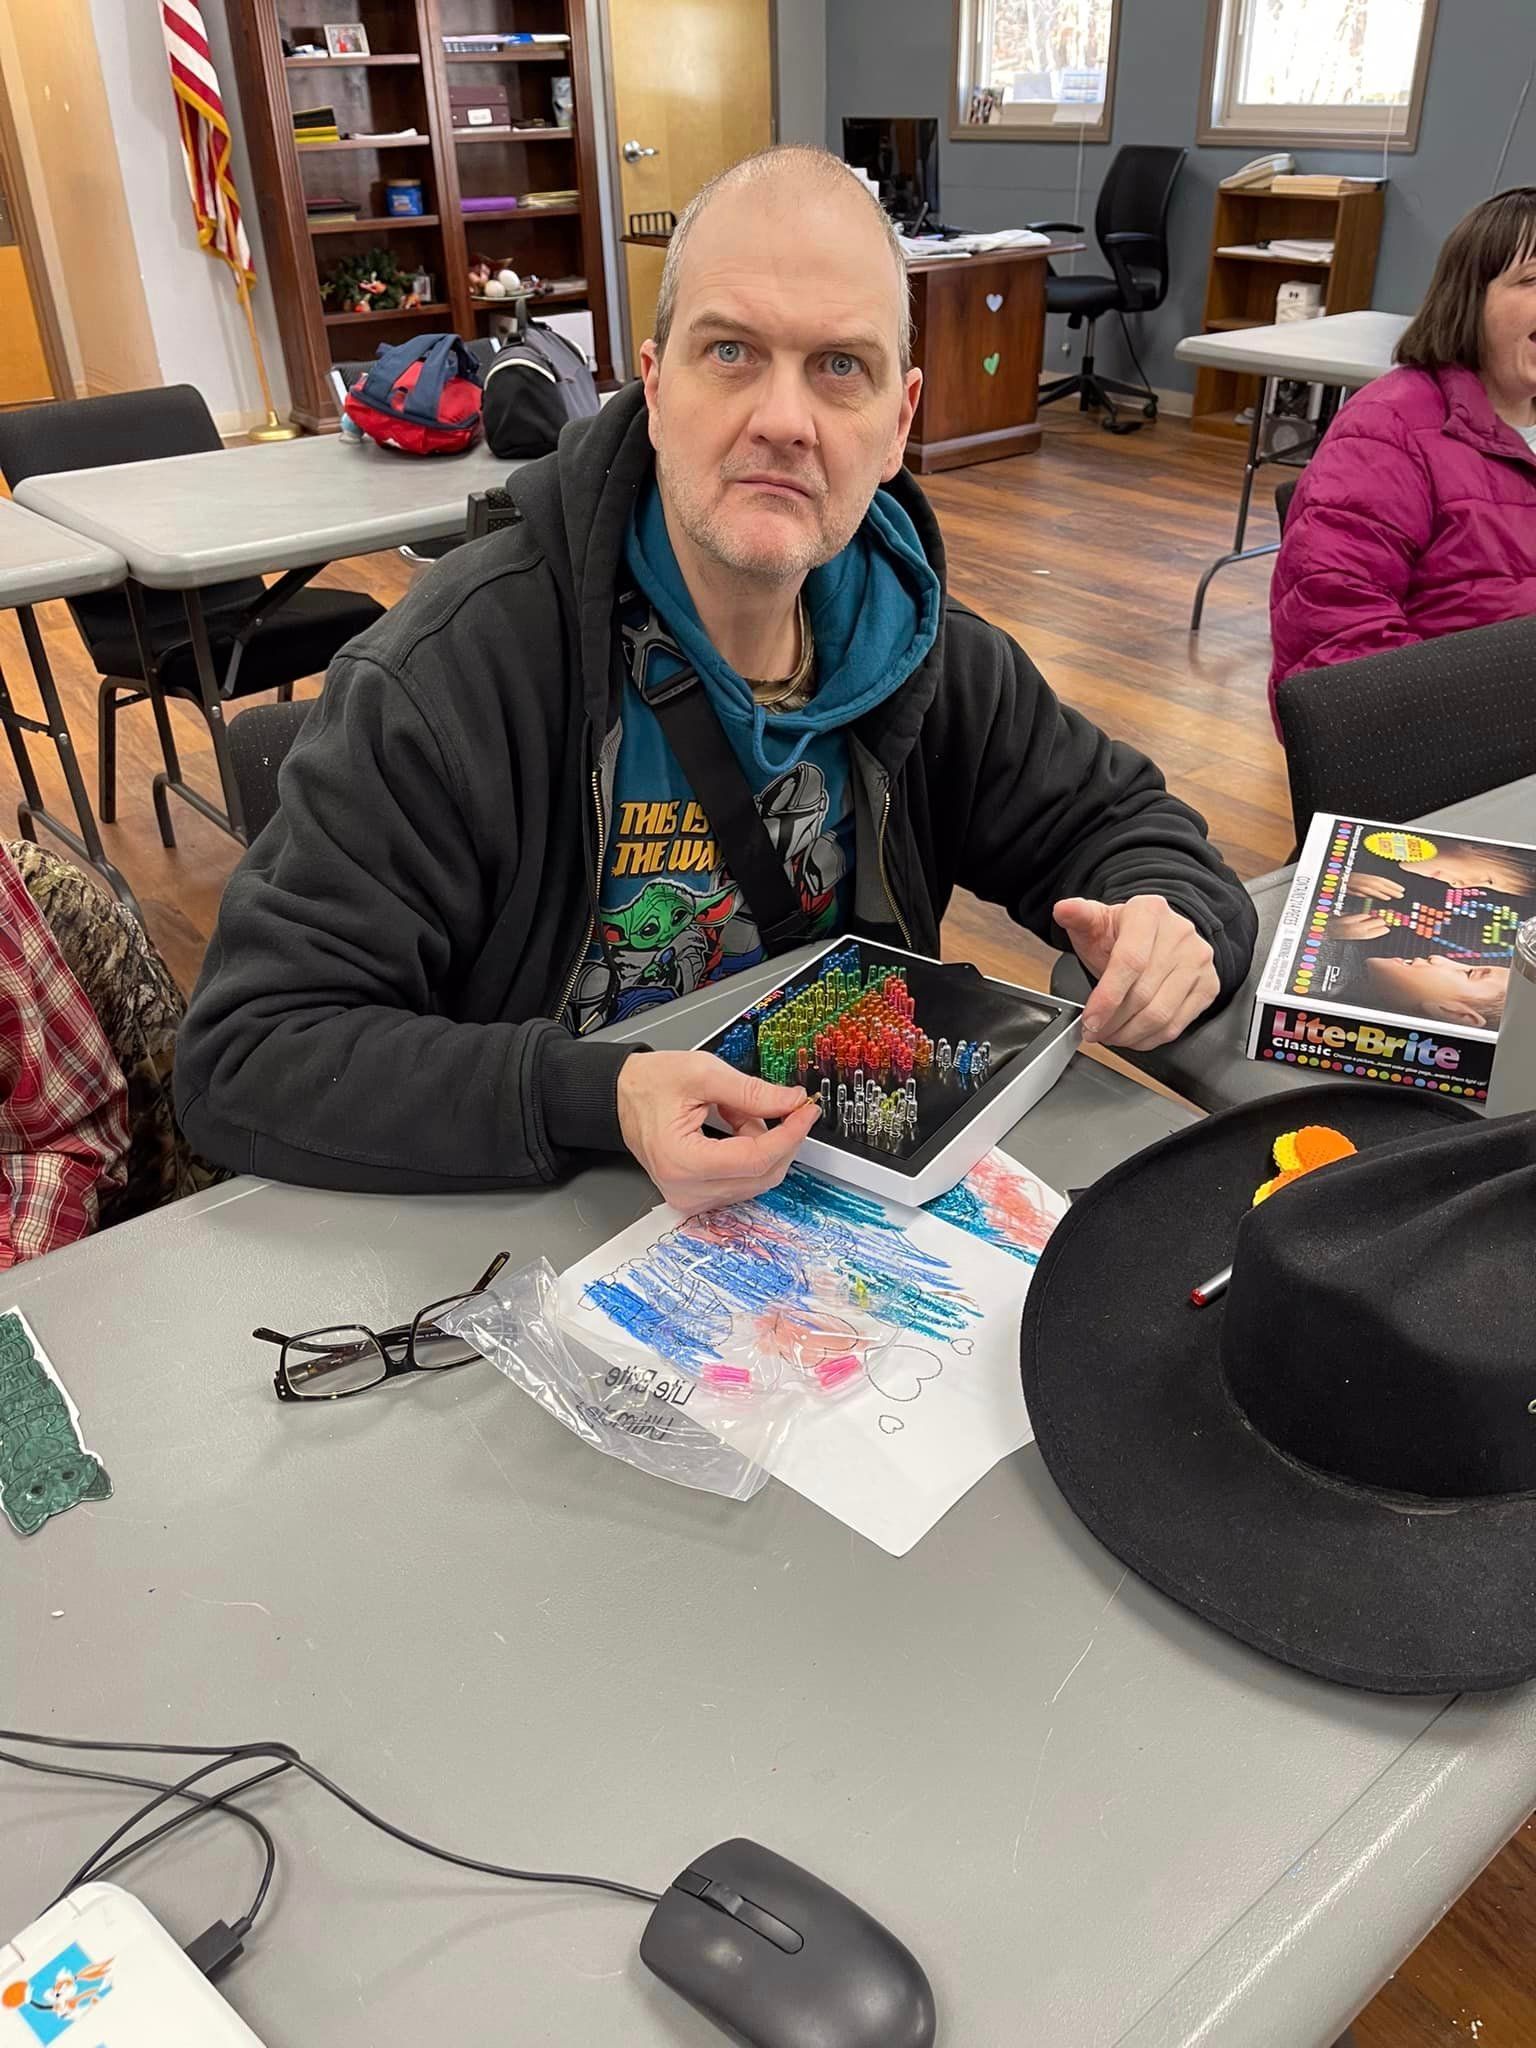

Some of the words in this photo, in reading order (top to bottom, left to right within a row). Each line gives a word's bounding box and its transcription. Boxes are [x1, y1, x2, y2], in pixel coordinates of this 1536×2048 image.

[620, 801, 681, 834] THIS
[681, 802, 710, 833] IS
[611, 841, 669, 877] THE
[668, 840, 718, 871] WA
[1272, 1037, 1332, 1057] Classic
